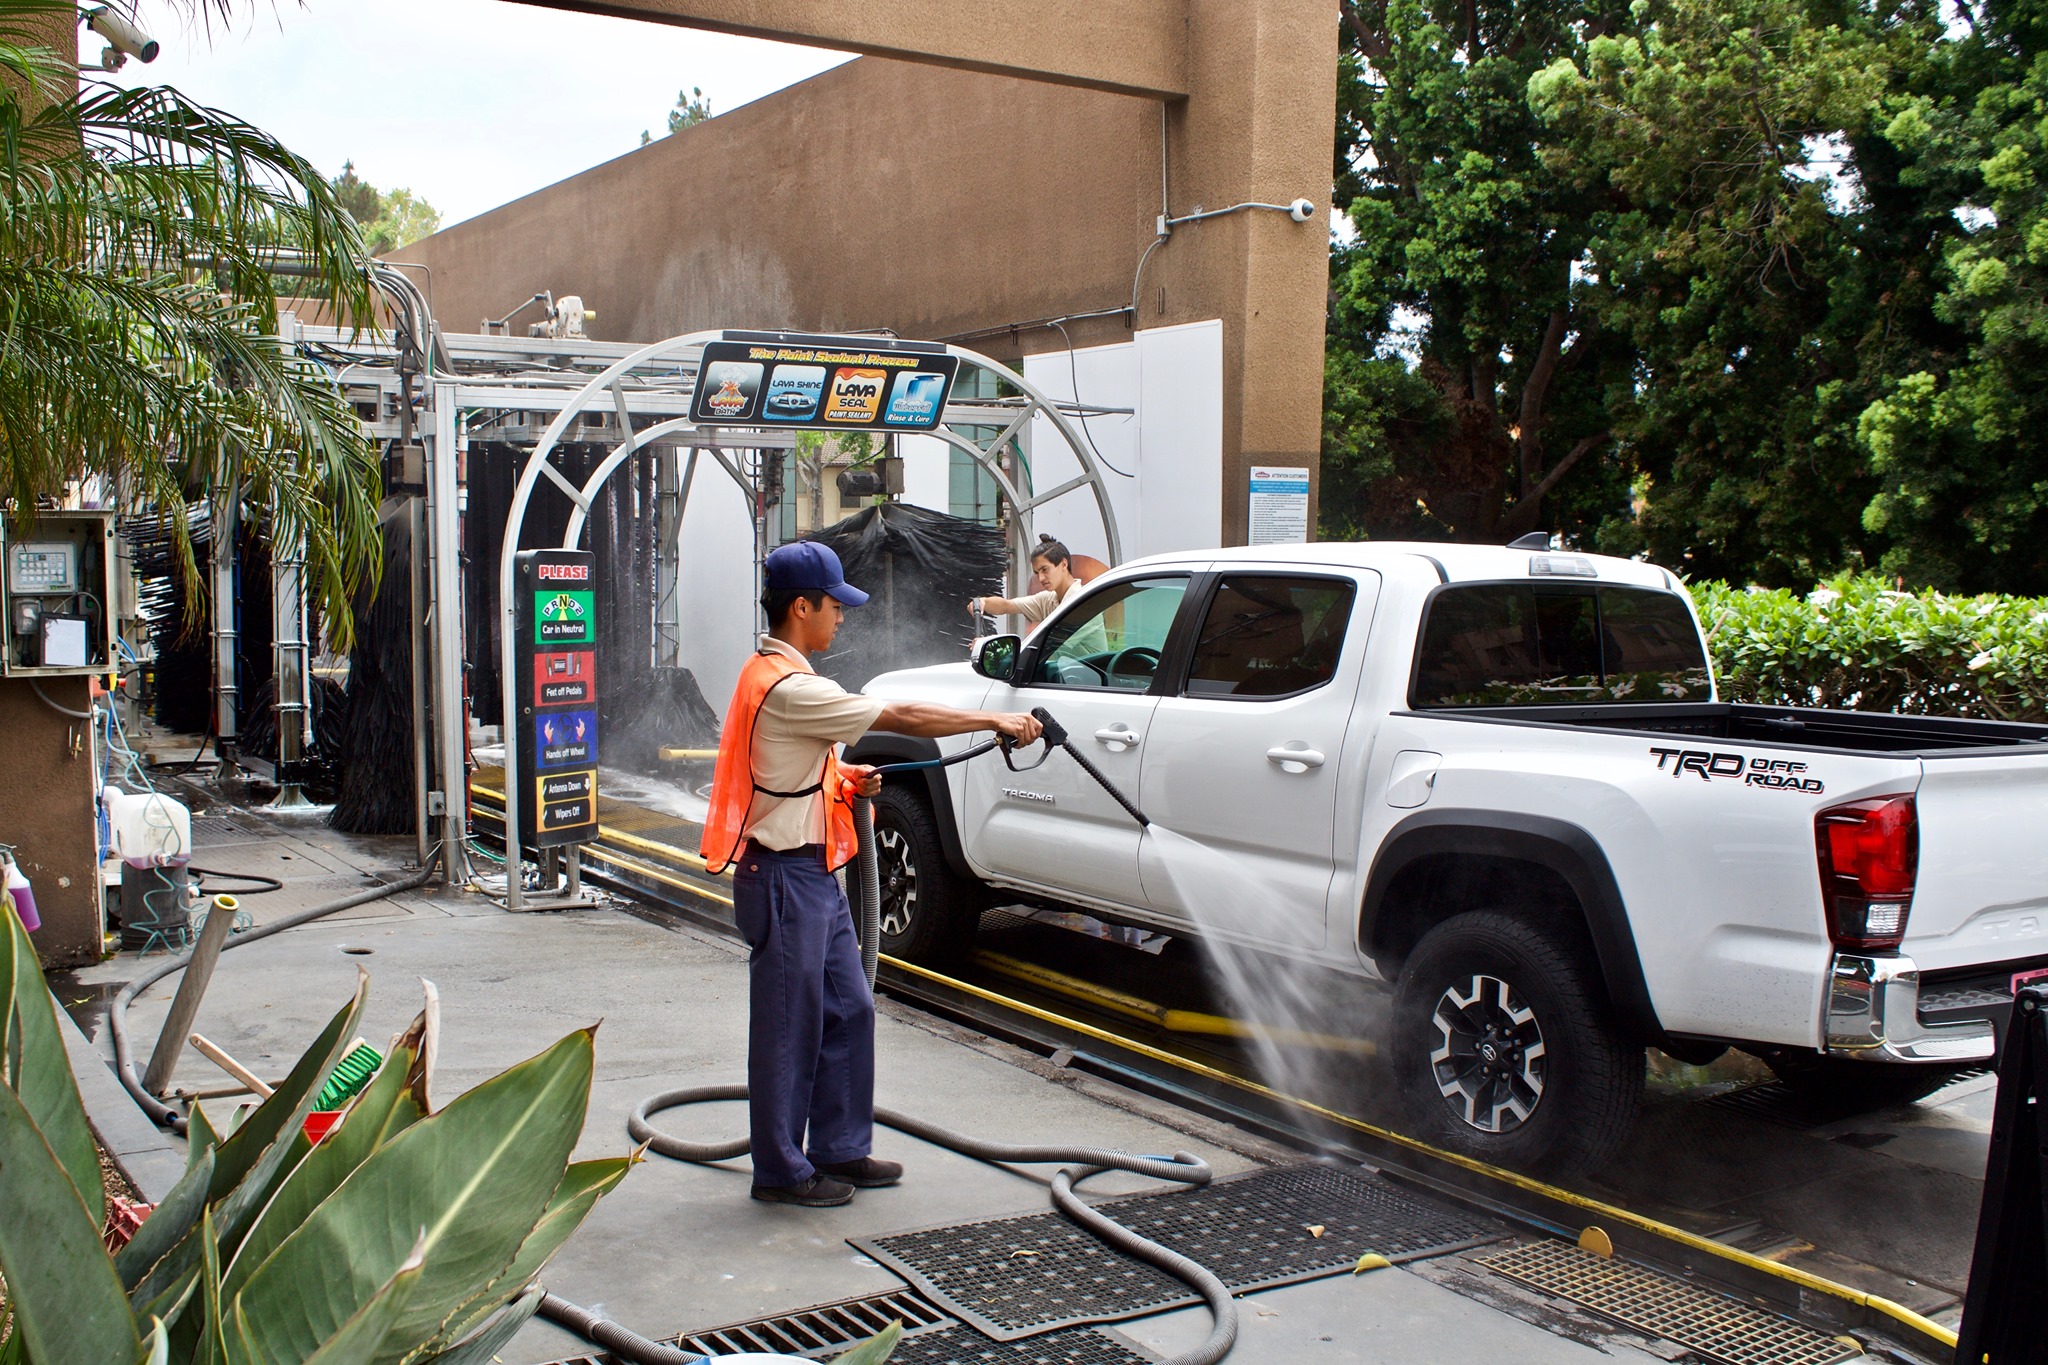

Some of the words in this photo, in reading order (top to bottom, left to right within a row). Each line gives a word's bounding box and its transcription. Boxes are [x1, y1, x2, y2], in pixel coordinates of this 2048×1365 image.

[749, 347, 776, 359] The
[776, 349, 814, 360] Paint
[813, 351, 866, 364] Sealant
[865, 354, 919, 368] Process
[772, 380, 795, 388] LAVA
[797, 381, 822, 389] SHINE
[836, 383, 877, 398] LAVA
[708, 395, 745, 409] LAVA
[839, 398, 868, 408] SEAL
[715, 406, 736, 415] BATH
[828, 411, 847, 419] PAINT
[848, 411, 873, 419] SEALANT
[539, 565, 588, 579] PLEASE
[542, 625, 554, 634] Car
[555, 625, 561, 633] in
[562, 625, 584, 633] Neutral
[546, 688, 557, 697] Feet
[565, 686, 582, 695] Pedals
[545, 750, 562, 759] Hands
[562, 749, 570, 758] off
[570, 747, 585, 756] Wheel
[1650, 747, 1746, 783] TRD
[1749, 758, 1808, 773] OFF
[548, 784, 568, 794] Antenna
[568, 781, 582, 792] Down
[1745, 773, 1825, 795] ROAD
[1002, 787, 1054, 803] TACOMA
[555, 808, 572, 820] Wipers
[572, 806, 580, 816] Off
